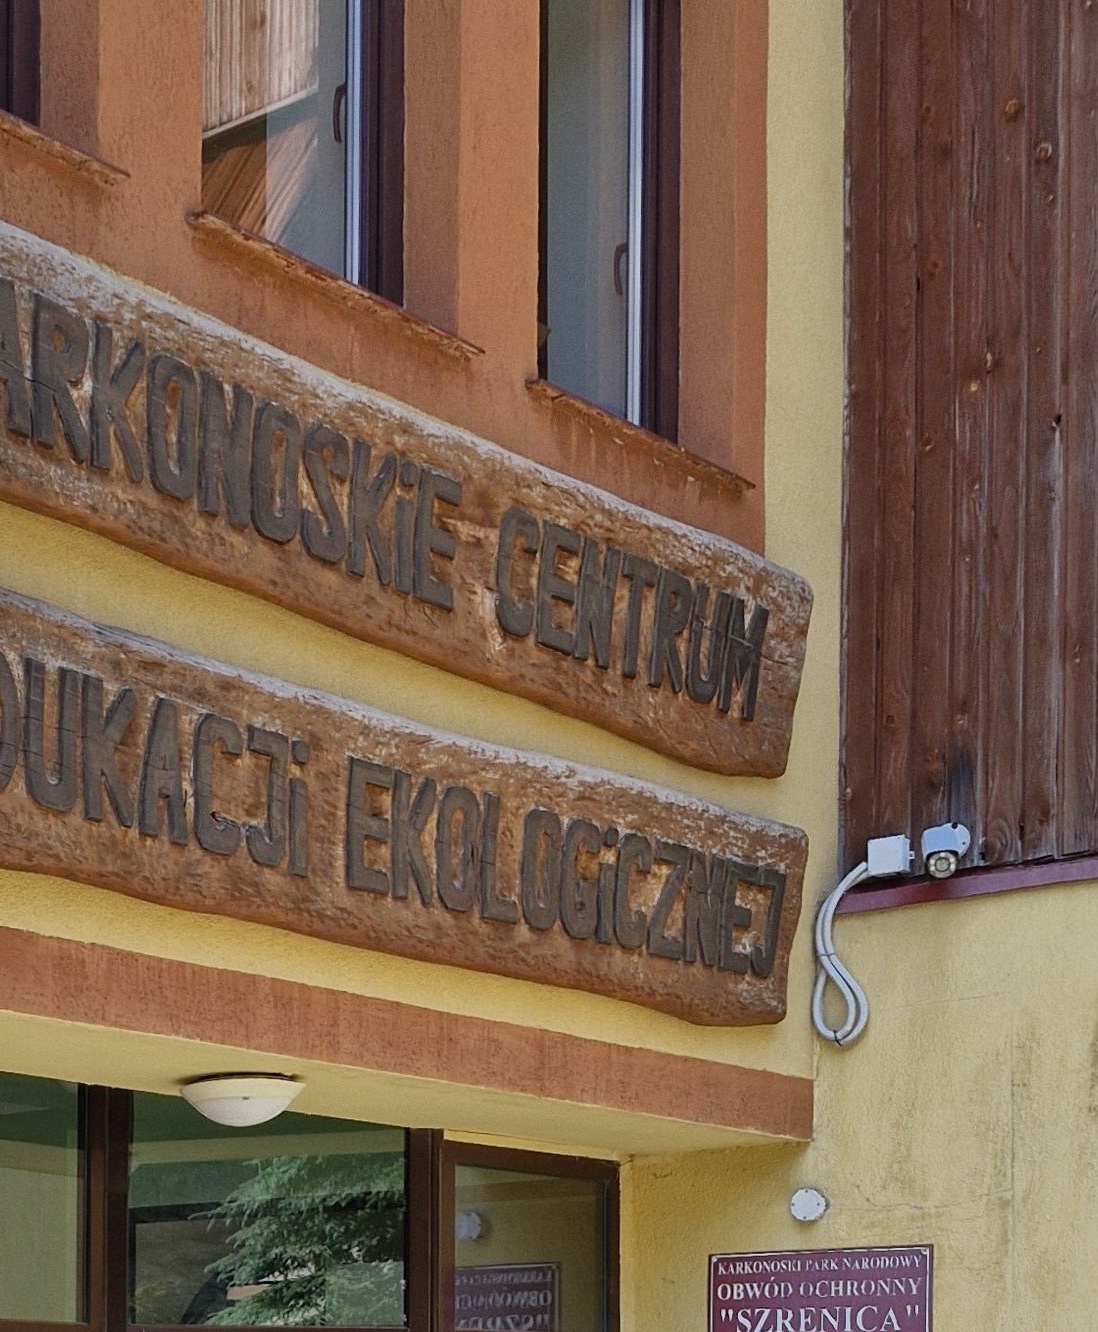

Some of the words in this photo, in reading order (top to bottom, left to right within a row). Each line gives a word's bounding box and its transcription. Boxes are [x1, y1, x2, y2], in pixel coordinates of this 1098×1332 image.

[496, 504, 769, 722] CENTRUM
[717, 1259, 802, 1276] KARKONOSKI
[805, 1258, 839, 1272] PARK
[842, 1255, 923, 1270] NARODOWY
[717, 1276, 793, 1301] OBWÓD
[799, 1277, 923, 1298] OCHRONNY
